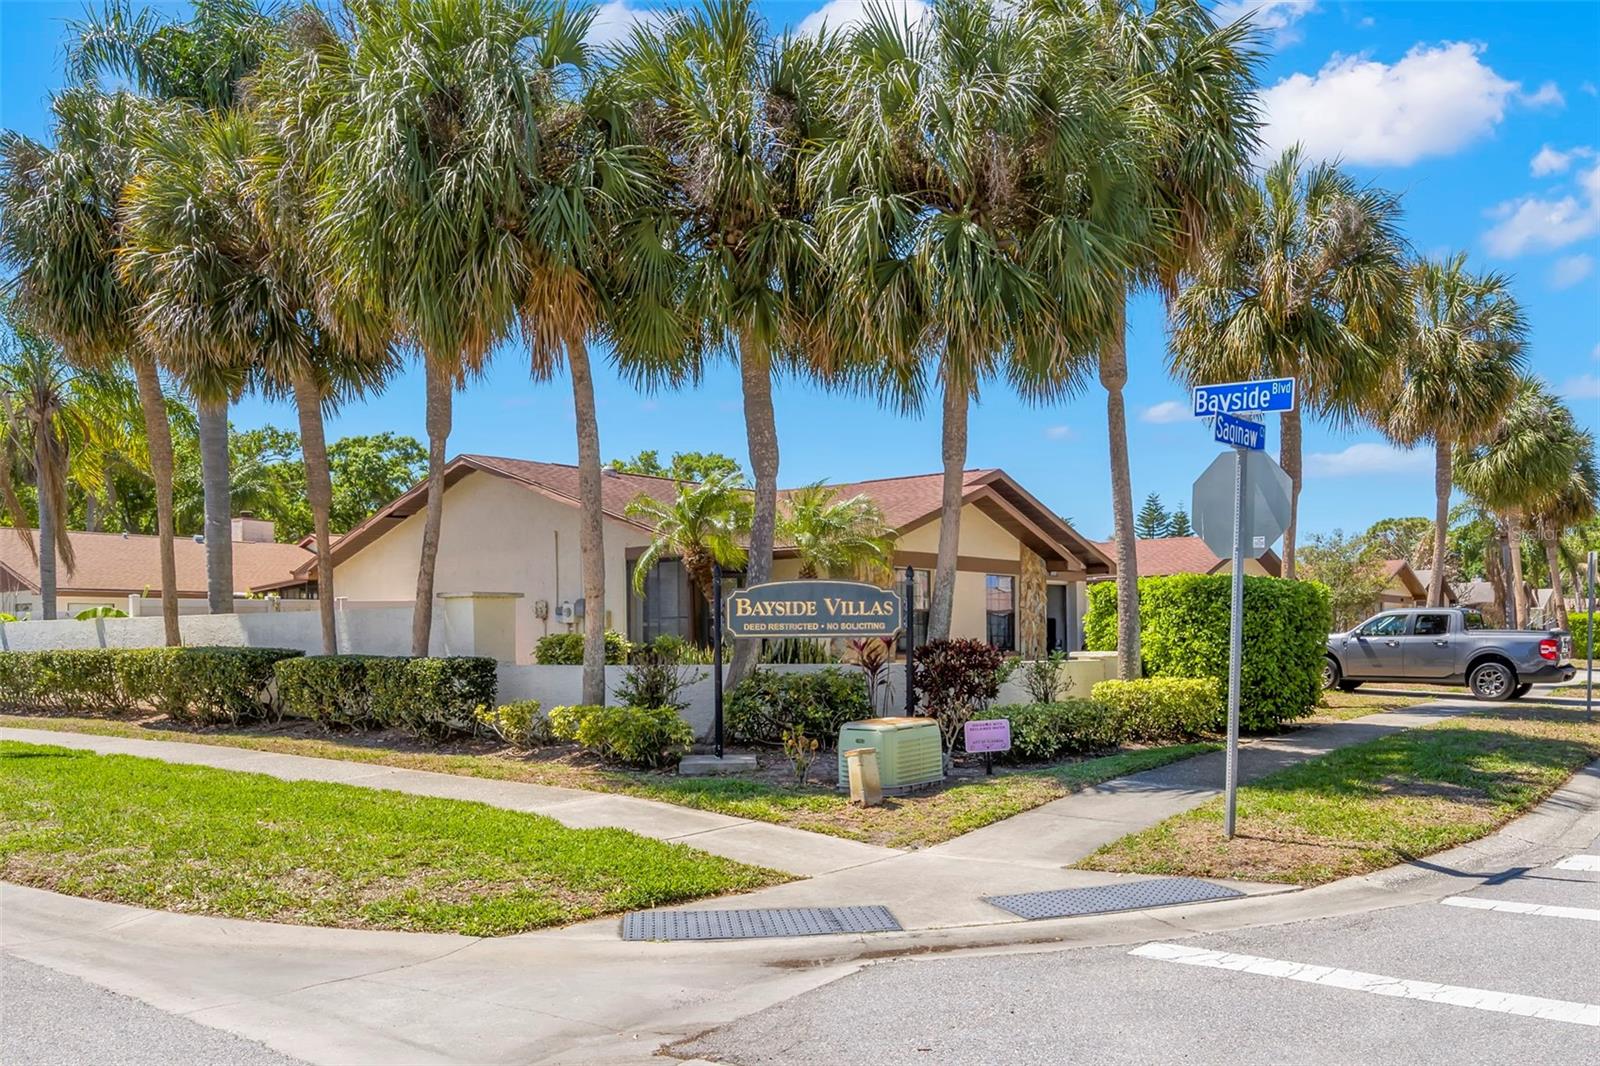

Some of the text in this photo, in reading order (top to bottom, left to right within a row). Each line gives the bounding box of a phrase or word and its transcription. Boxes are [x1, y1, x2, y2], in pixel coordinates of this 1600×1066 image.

[1196, 382, 1291, 413] Bayside Blvd
[1216, 415, 1258, 448] Saginaw
[735, 598, 894, 617] BAYSIDE VILLAS
[743, 622, 886, 631] DEED RESTRICTED NO SOLICITING
